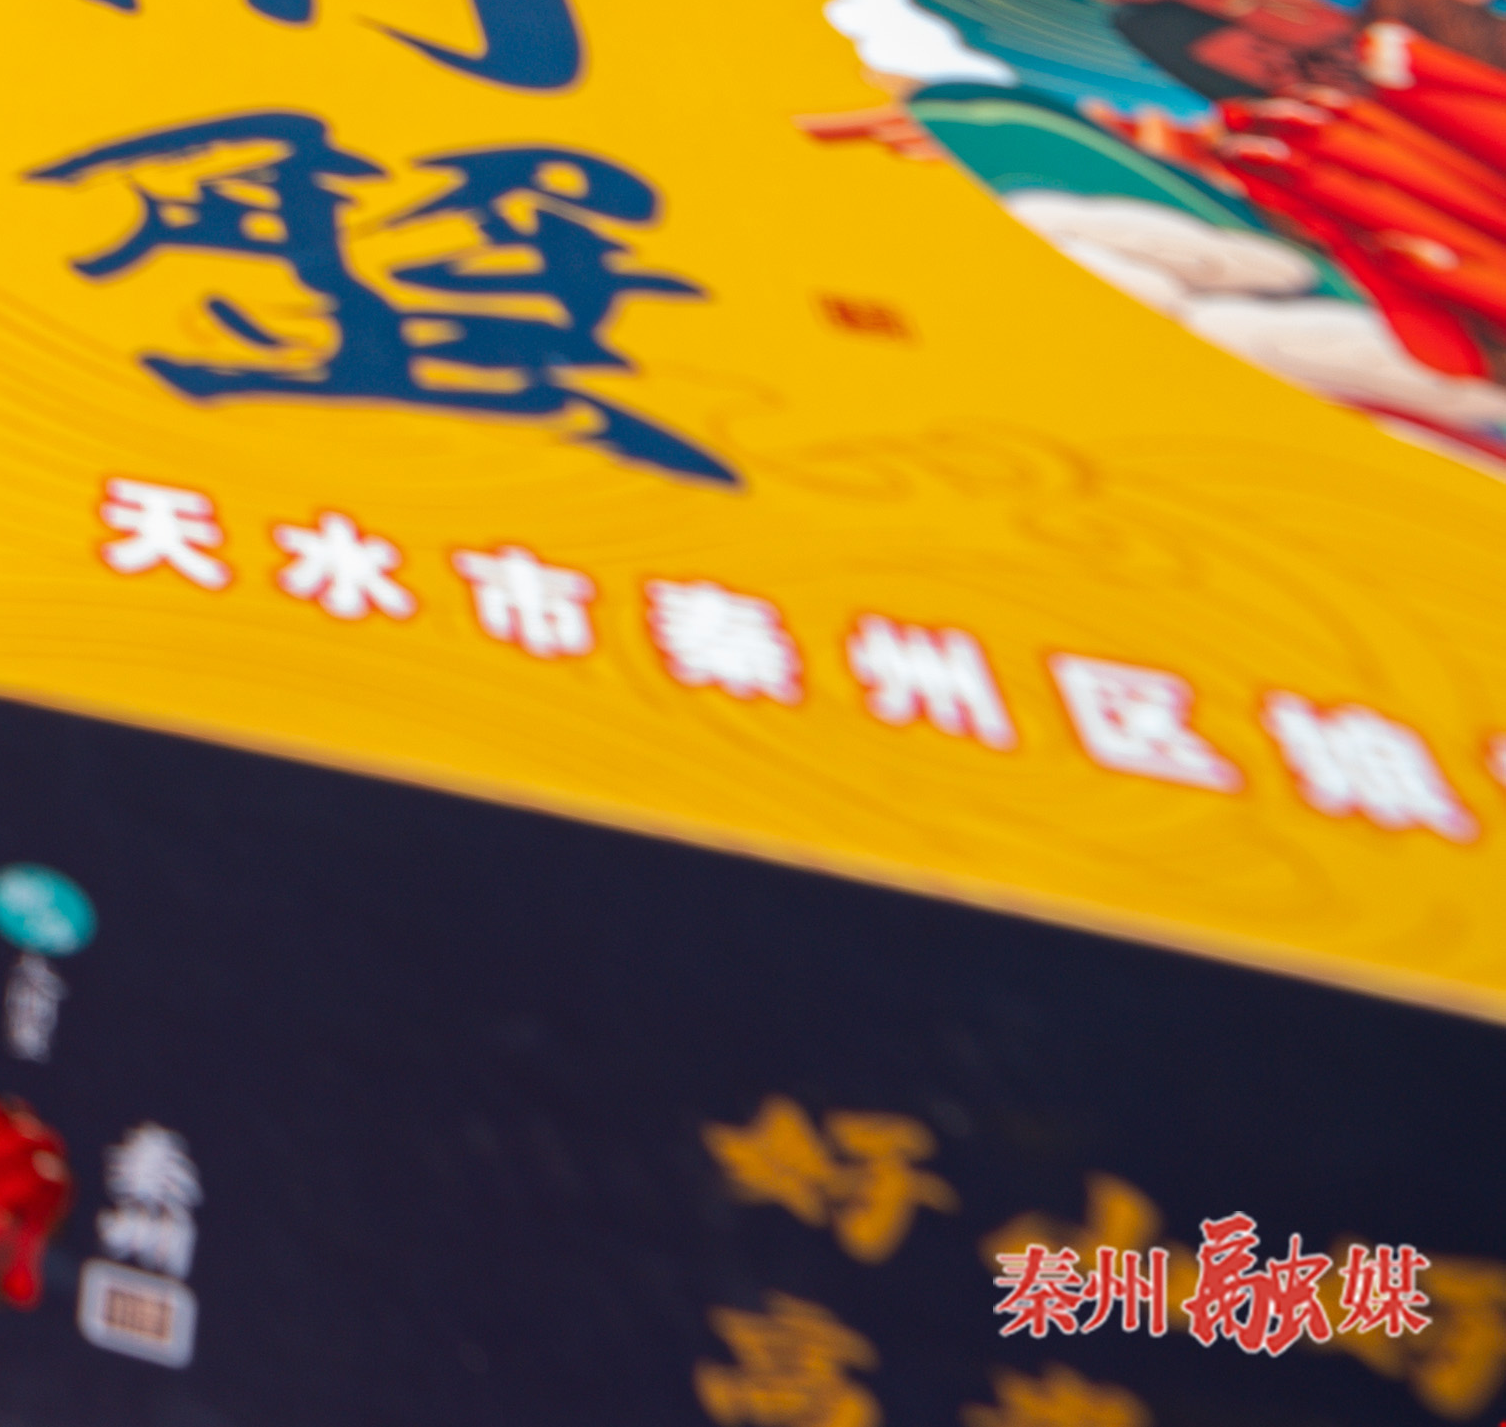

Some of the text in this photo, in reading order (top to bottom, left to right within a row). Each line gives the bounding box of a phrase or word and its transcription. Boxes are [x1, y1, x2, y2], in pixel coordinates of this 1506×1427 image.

[102, 476, 1506, 842] 天水市秦州区娘
